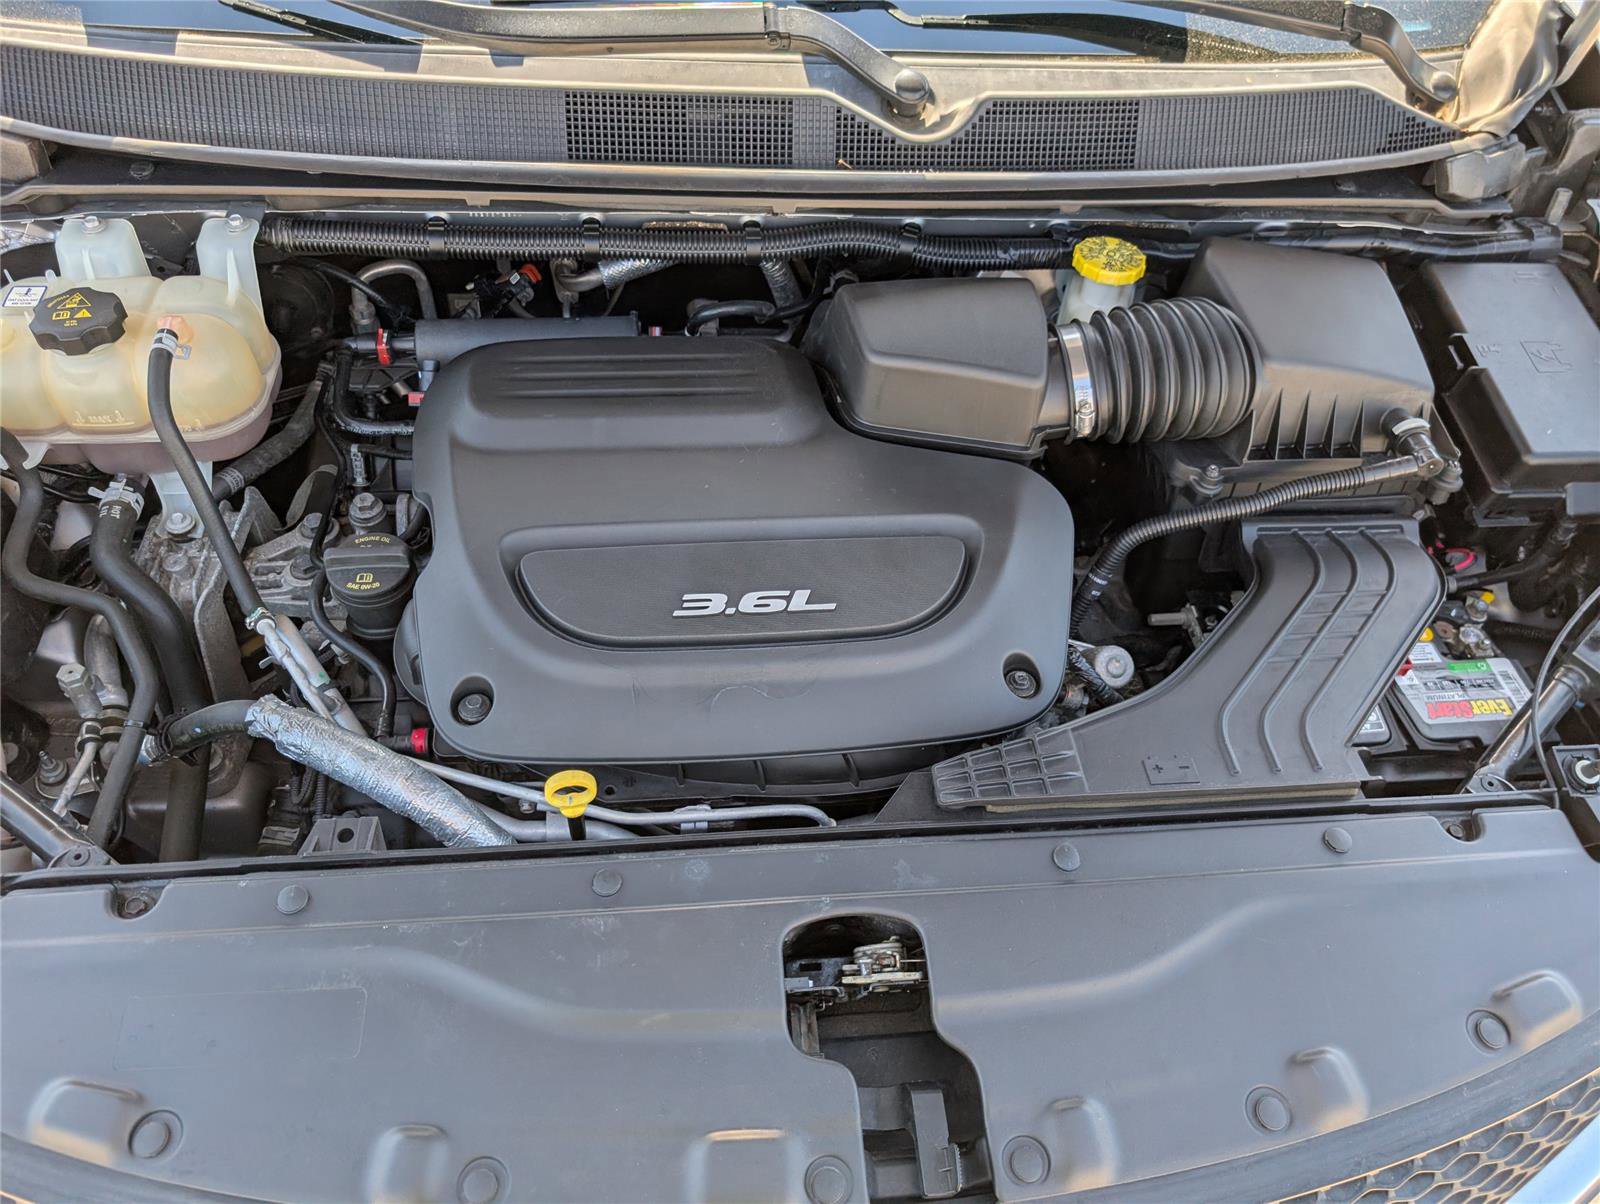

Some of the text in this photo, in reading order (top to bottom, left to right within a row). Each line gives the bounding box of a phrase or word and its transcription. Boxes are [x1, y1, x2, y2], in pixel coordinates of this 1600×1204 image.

[355, 536, 391, 544] ENGINE OIL
[346, 582, 380, 590] SAE 0W-20
[672, 589, 837, 617] 3.6L
[1426, 699, 1513, 720] EverStart
